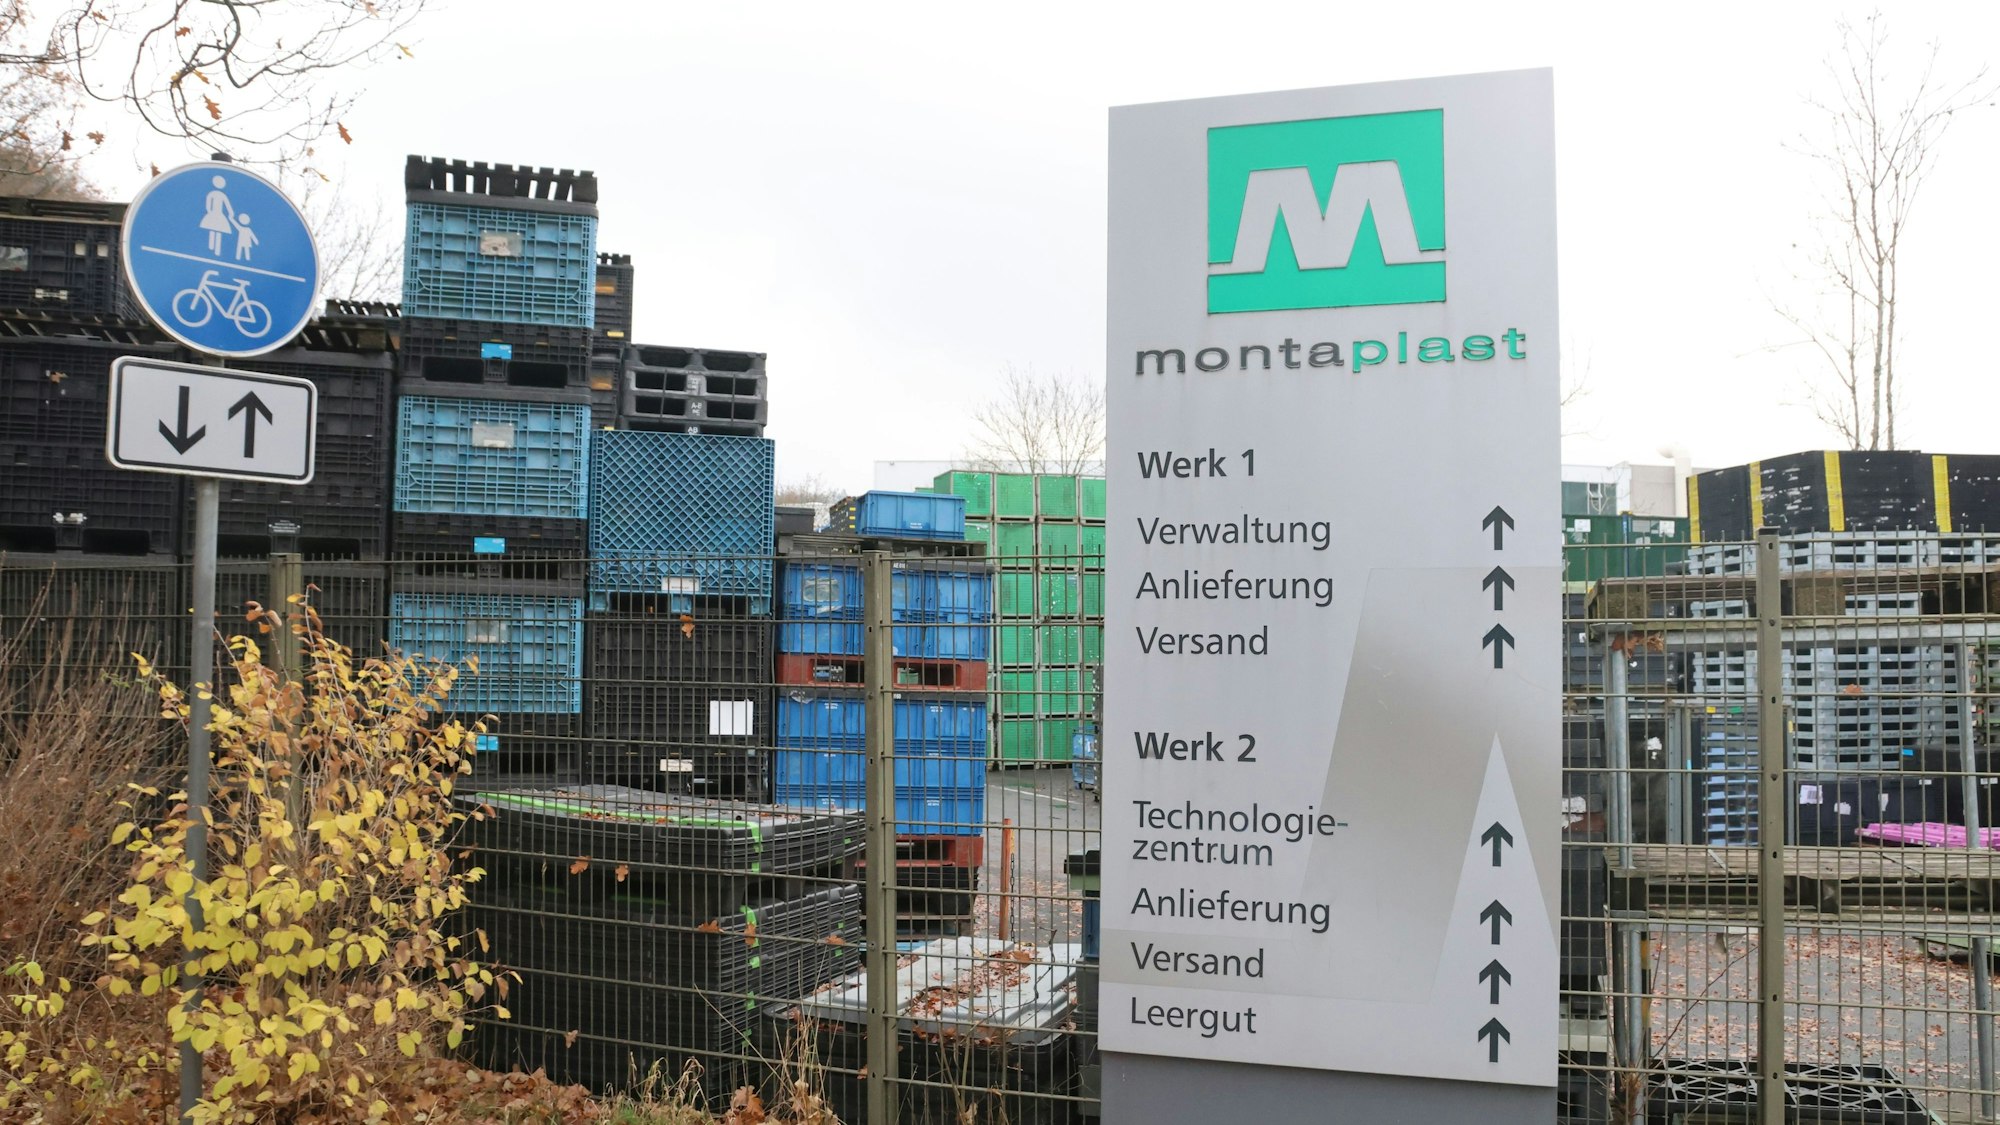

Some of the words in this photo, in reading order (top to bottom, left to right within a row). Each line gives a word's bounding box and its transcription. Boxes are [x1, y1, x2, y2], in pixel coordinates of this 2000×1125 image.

[1135, 327, 1527, 375] montaplast
[1137, 447, 1228, 479] Werk
[1241, 448, 1254, 477] 1
[1136, 513, 1331, 552] Verwaltung
[1135, 568, 1333, 608] Anlieferung
[1135, 625, 1268, 656] Versand
[1133, 731, 1225, 762] Werk
[1237, 733, 1257, 763] 2
[1132, 800, 1349, 843] Technologie-
[1132, 836, 1273, 867] zentrum
[1130, 887, 1330, 934] Anlieferung
[1130, 941, 1264, 978] Versand
[1131, 996, 1257, 1039] Leergut
